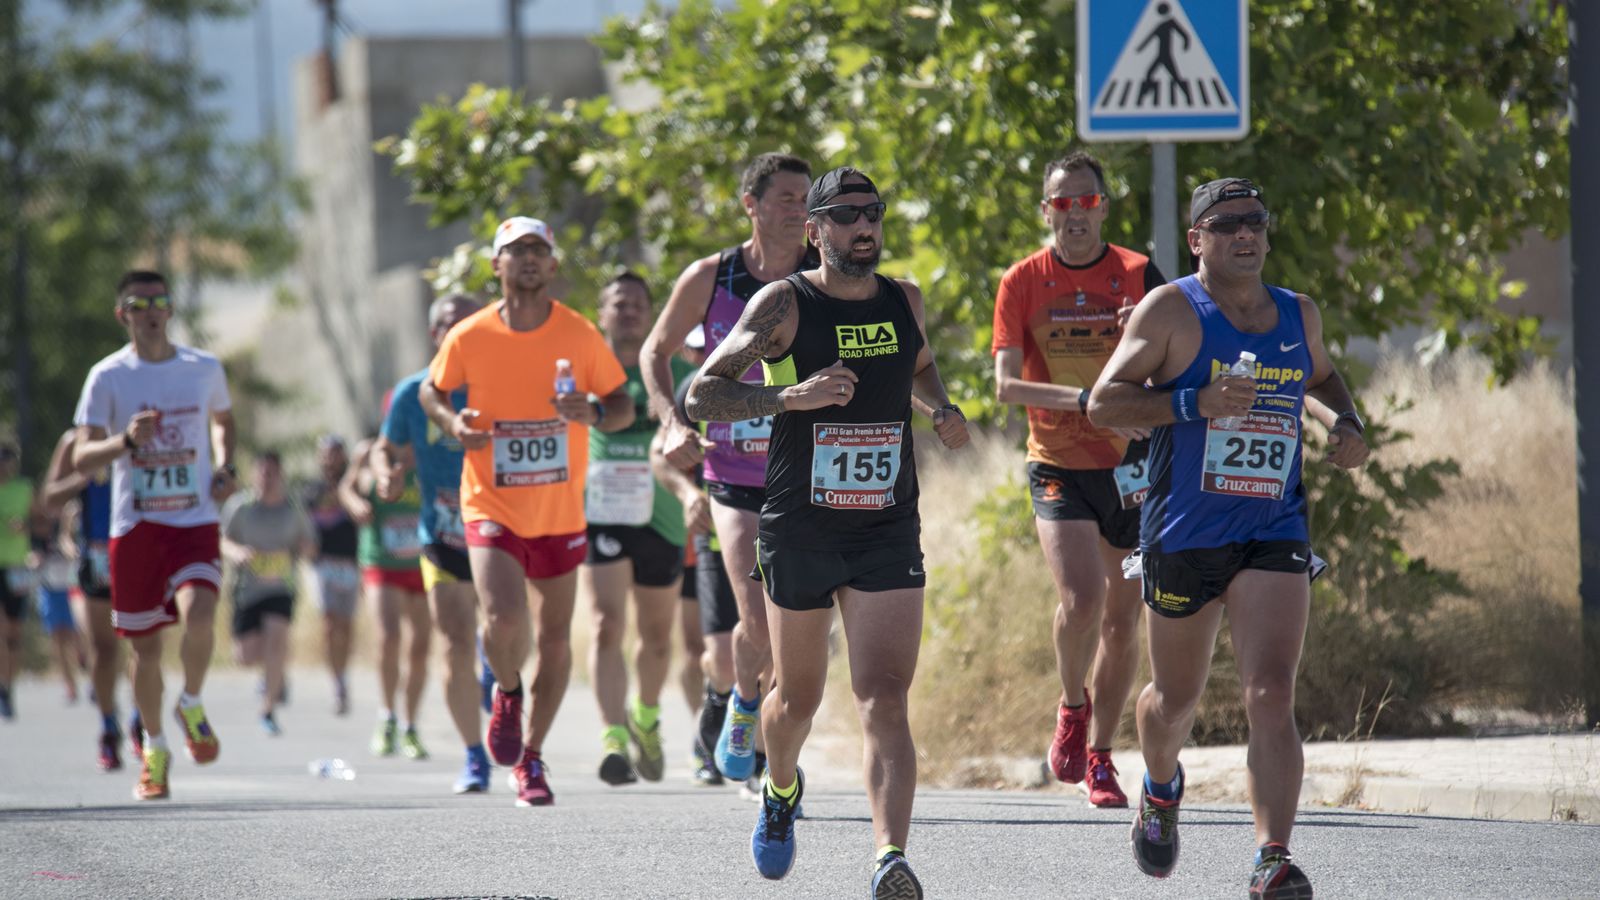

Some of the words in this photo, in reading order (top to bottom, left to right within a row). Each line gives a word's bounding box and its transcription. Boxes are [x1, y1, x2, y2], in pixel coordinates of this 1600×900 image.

[839, 325, 894, 346] FILA
[839, 349, 863, 358] ROAD
[864, 345, 898, 357] RUNNER
[1249, 413, 1269, 424] Premio
[1270, 415, 1277, 424] de
[839, 427, 853, 436] Gran
[854, 426, 875, 436] Premio
[875, 426, 882, 435] de
[882, 425, 896, 435] Fond
[508, 437, 557, 464] 909
[1221, 436, 1287, 472] 258
[832, 450, 892, 483] 155
[144, 467, 189, 490] 718
[1215, 475, 1282, 497] Cruzcamp
[824, 490, 887, 508] Cruzcamp
